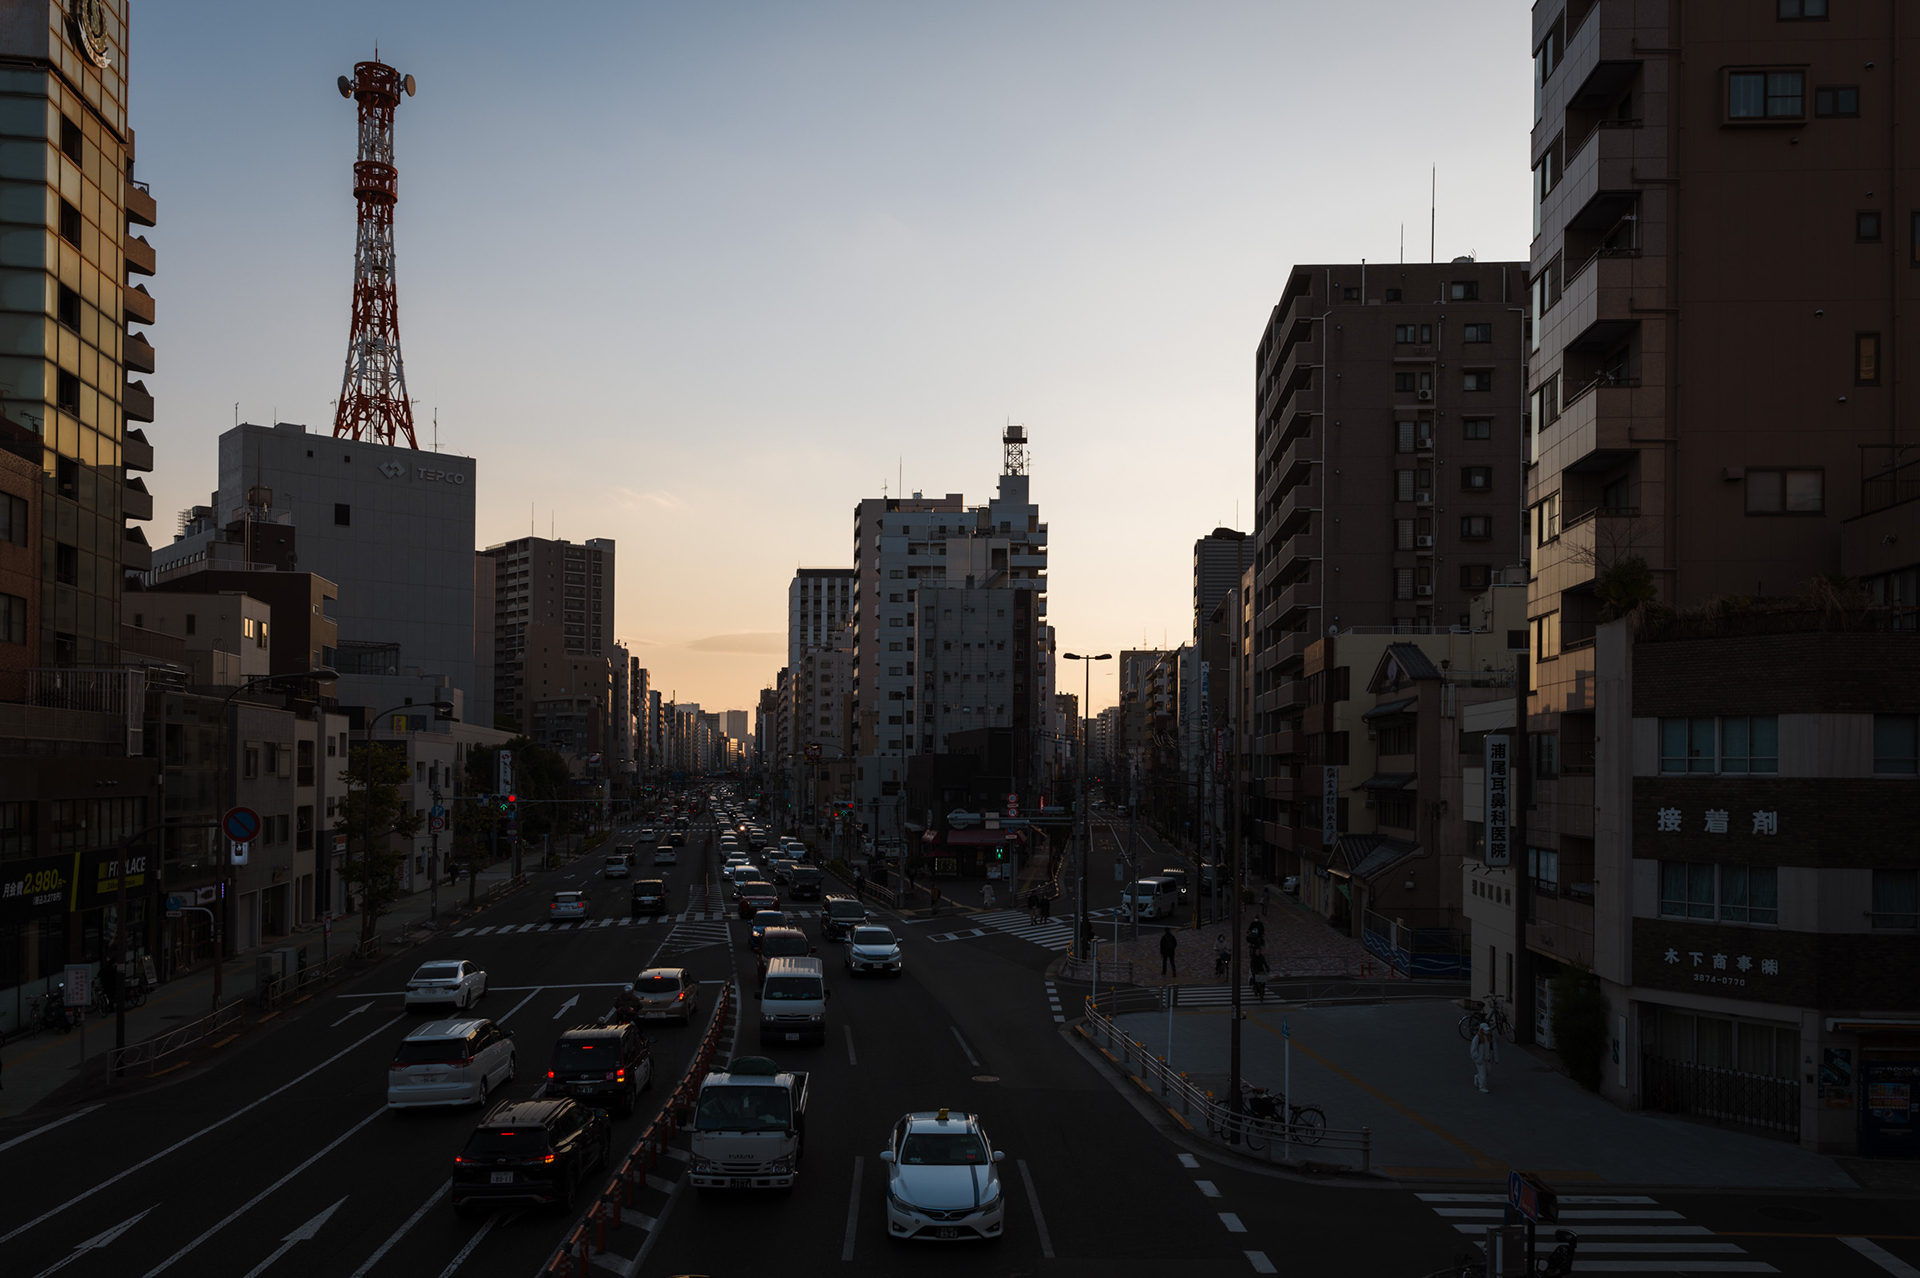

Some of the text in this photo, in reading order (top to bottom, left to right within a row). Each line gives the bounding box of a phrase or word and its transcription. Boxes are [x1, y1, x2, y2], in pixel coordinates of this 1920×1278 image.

[418, 467, 465, 485] TEPCO
[1490, 743, 1506, 858] 浦尾耳鼻科医院
[1657, 806, 1778, 836] 接着剤
[108, 856, 147, 878] FITLACE
[1693, 973, 1745, 987] 3874-0770
[1513, 1180, 1520, 1201] 4
